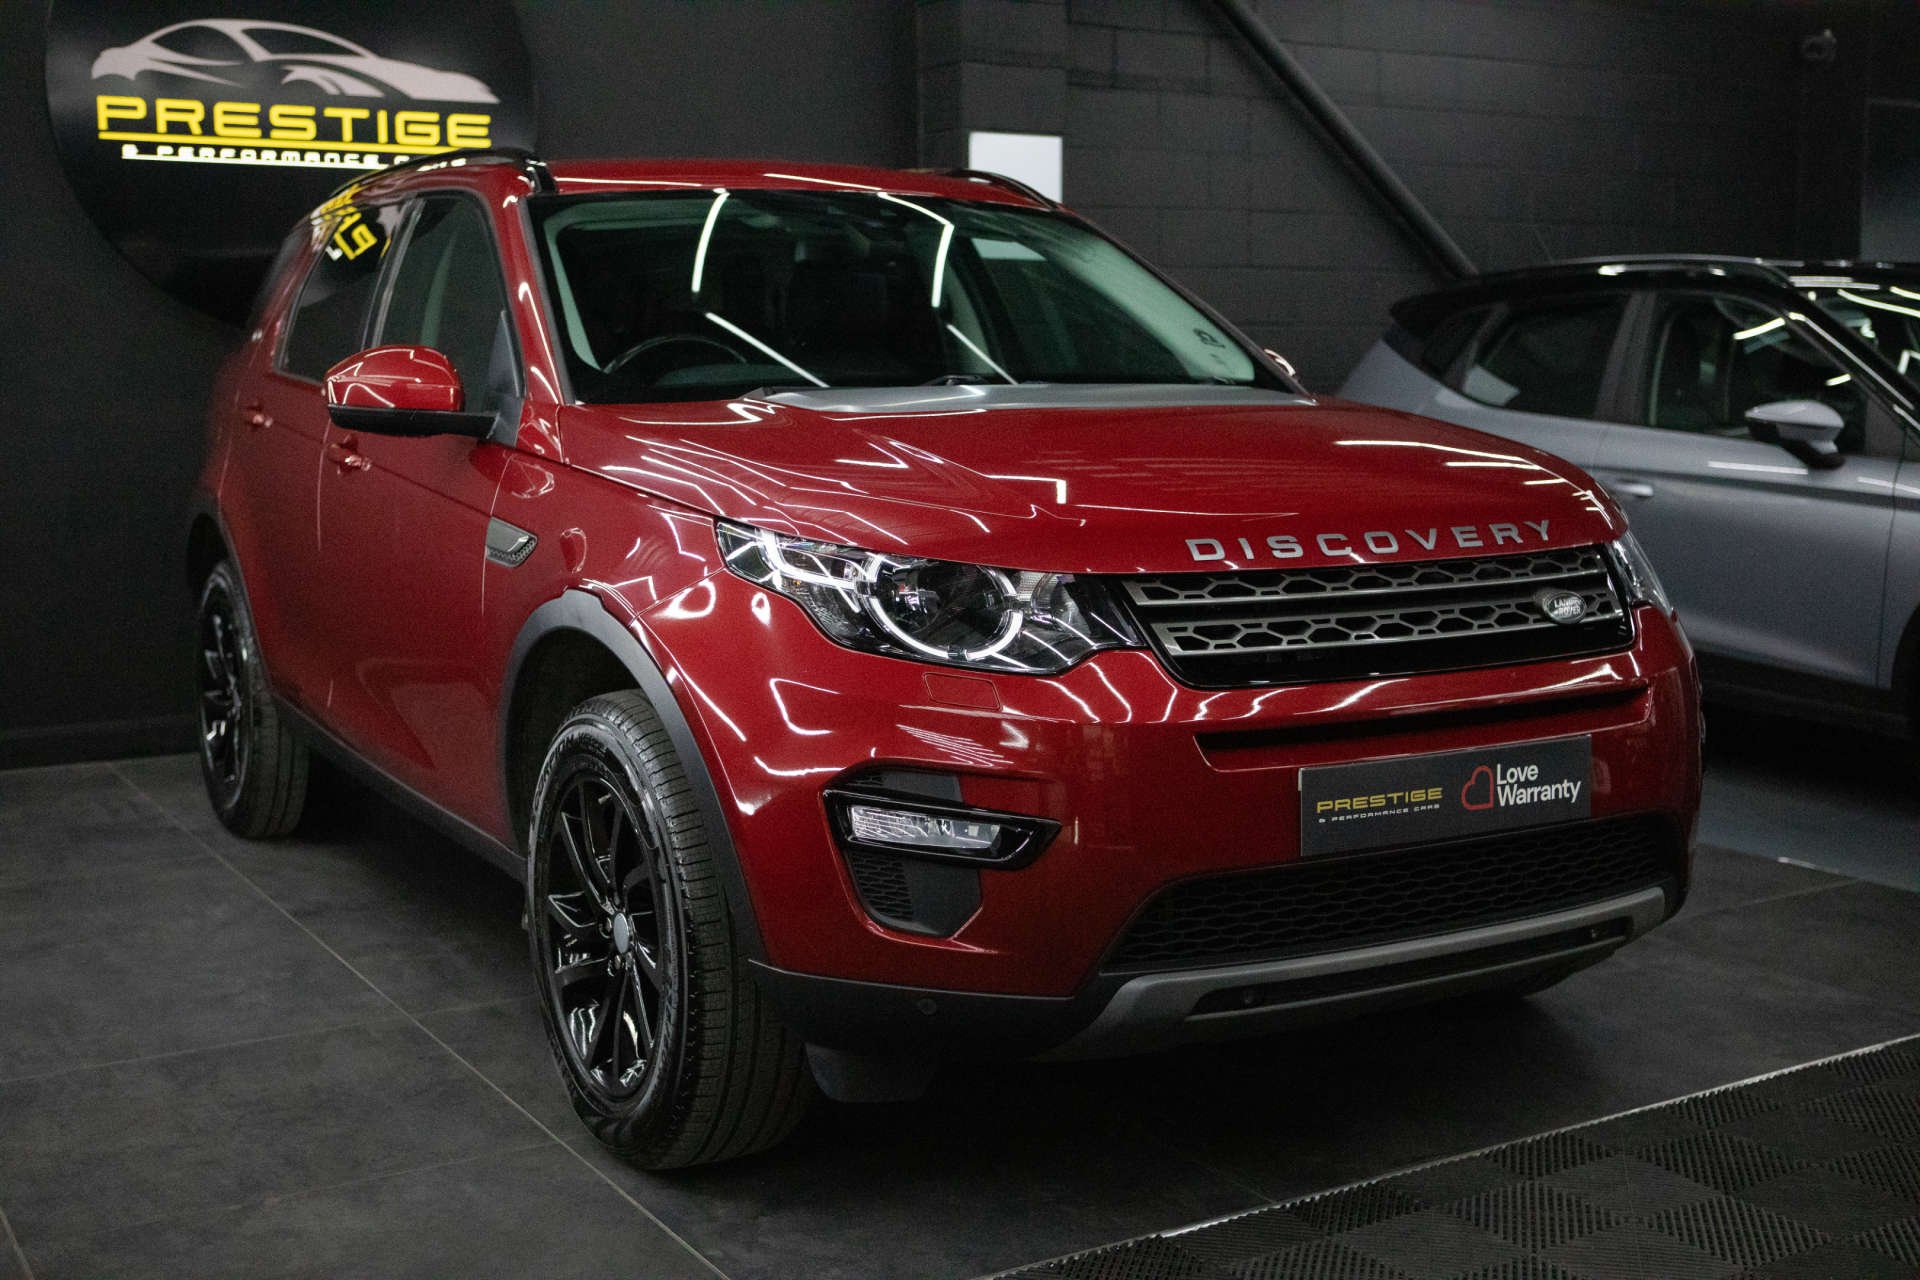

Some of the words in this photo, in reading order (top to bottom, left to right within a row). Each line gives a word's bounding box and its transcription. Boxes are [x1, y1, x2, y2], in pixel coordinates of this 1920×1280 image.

[96, 95, 492, 149] PRESTIGE
[1185, 519, 1551, 562] DISCOVERY
[1496, 763, 1539, 785] Love
[1316, 787, 1443, 814] PRESTIGE
[1497, 779, 1582, 808] Warranty
[1331, 807, 1409, 822] PERFORMANCE
[1413, 803, 1440, 812] CARS
